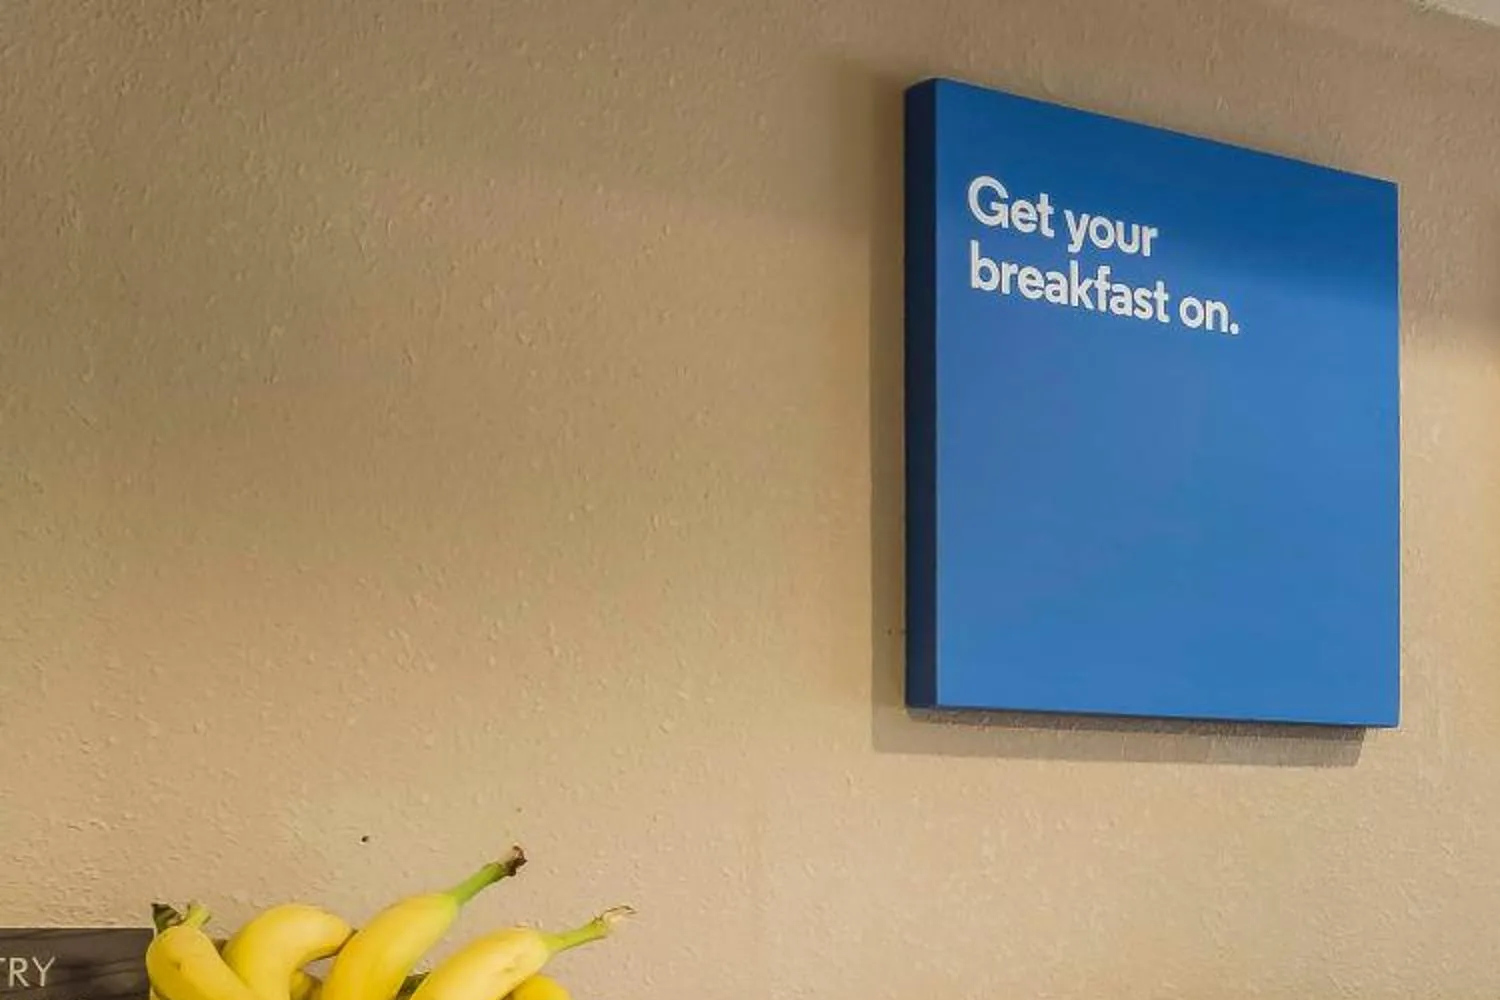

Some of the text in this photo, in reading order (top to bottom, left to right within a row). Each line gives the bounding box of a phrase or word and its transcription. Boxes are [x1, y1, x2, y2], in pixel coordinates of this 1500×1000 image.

[967, 175, 1159, 256] Get your
[970, 240, 1240, 335] breakfast on.
